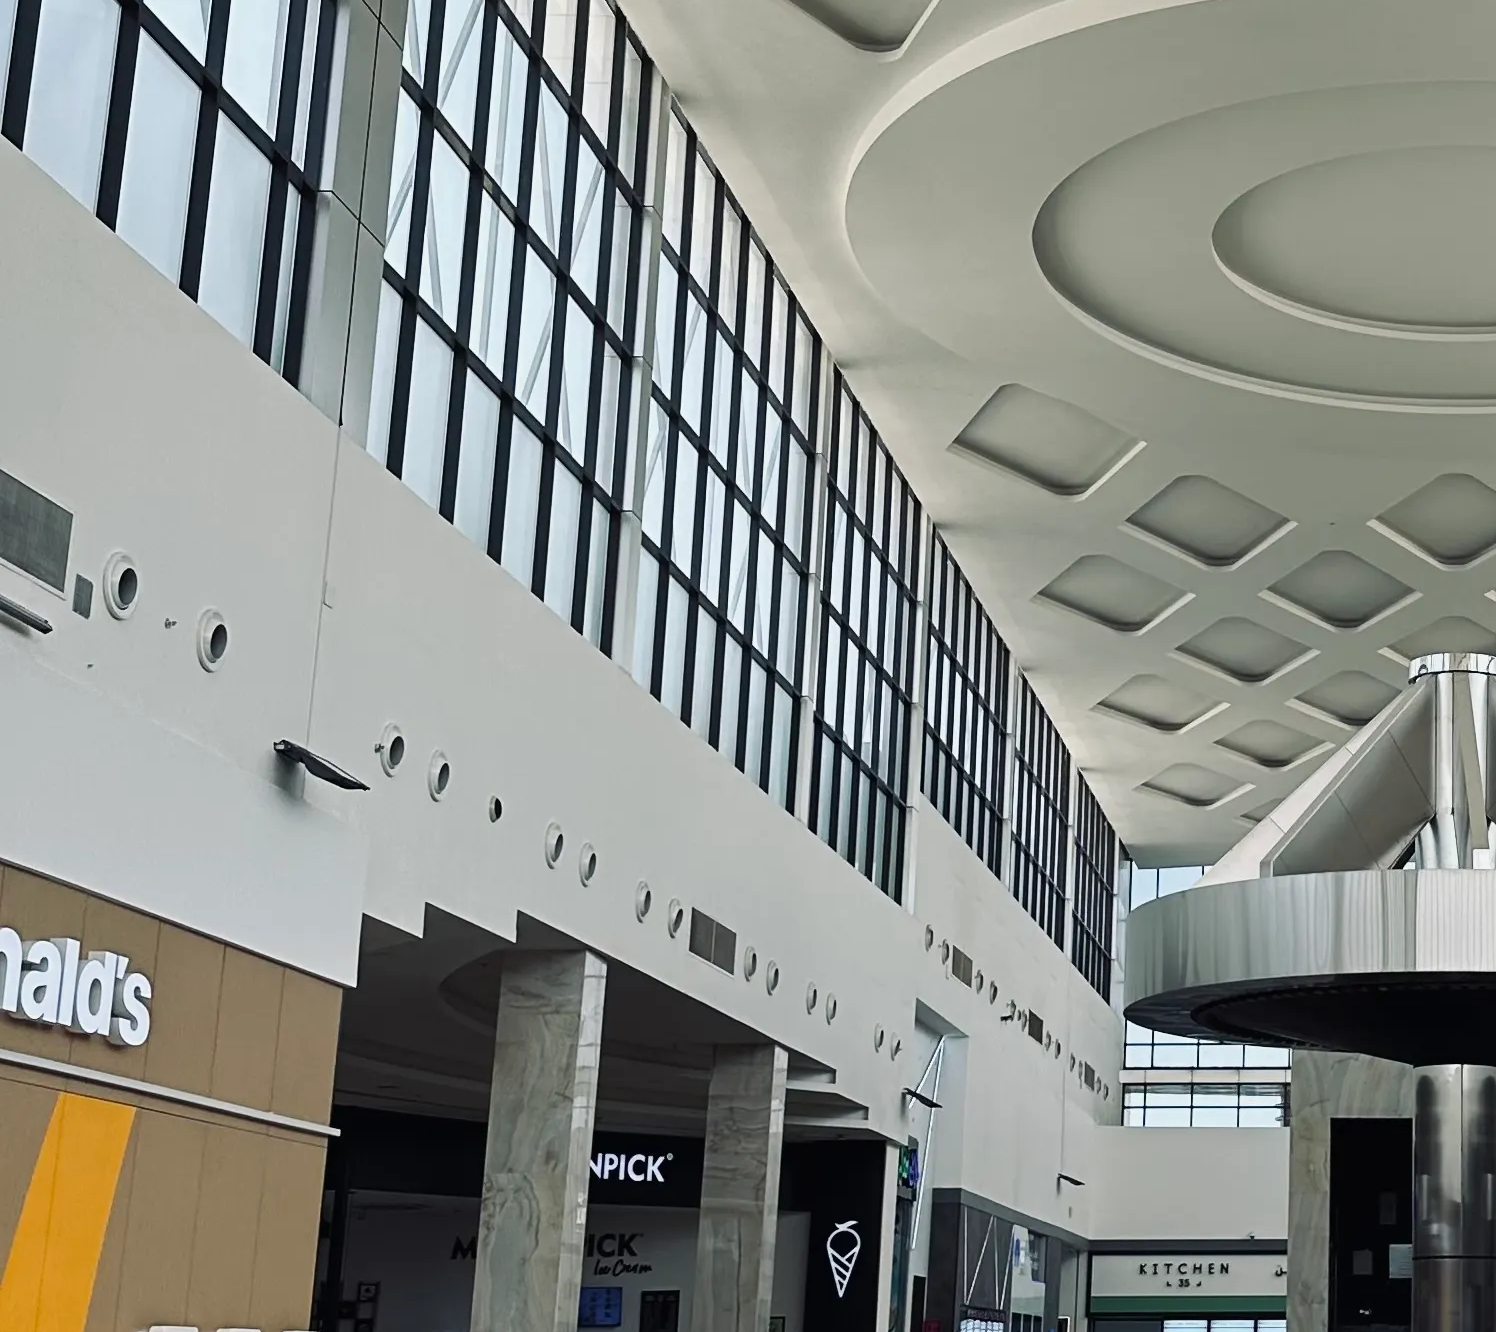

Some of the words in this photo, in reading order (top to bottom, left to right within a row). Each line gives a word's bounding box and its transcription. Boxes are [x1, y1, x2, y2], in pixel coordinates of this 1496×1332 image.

[584, 1233, 637, 1257] ICK
[1139, 1263, 1229, 1275] KITCHEN
[1178, 1278, 1190, 1288] 35
